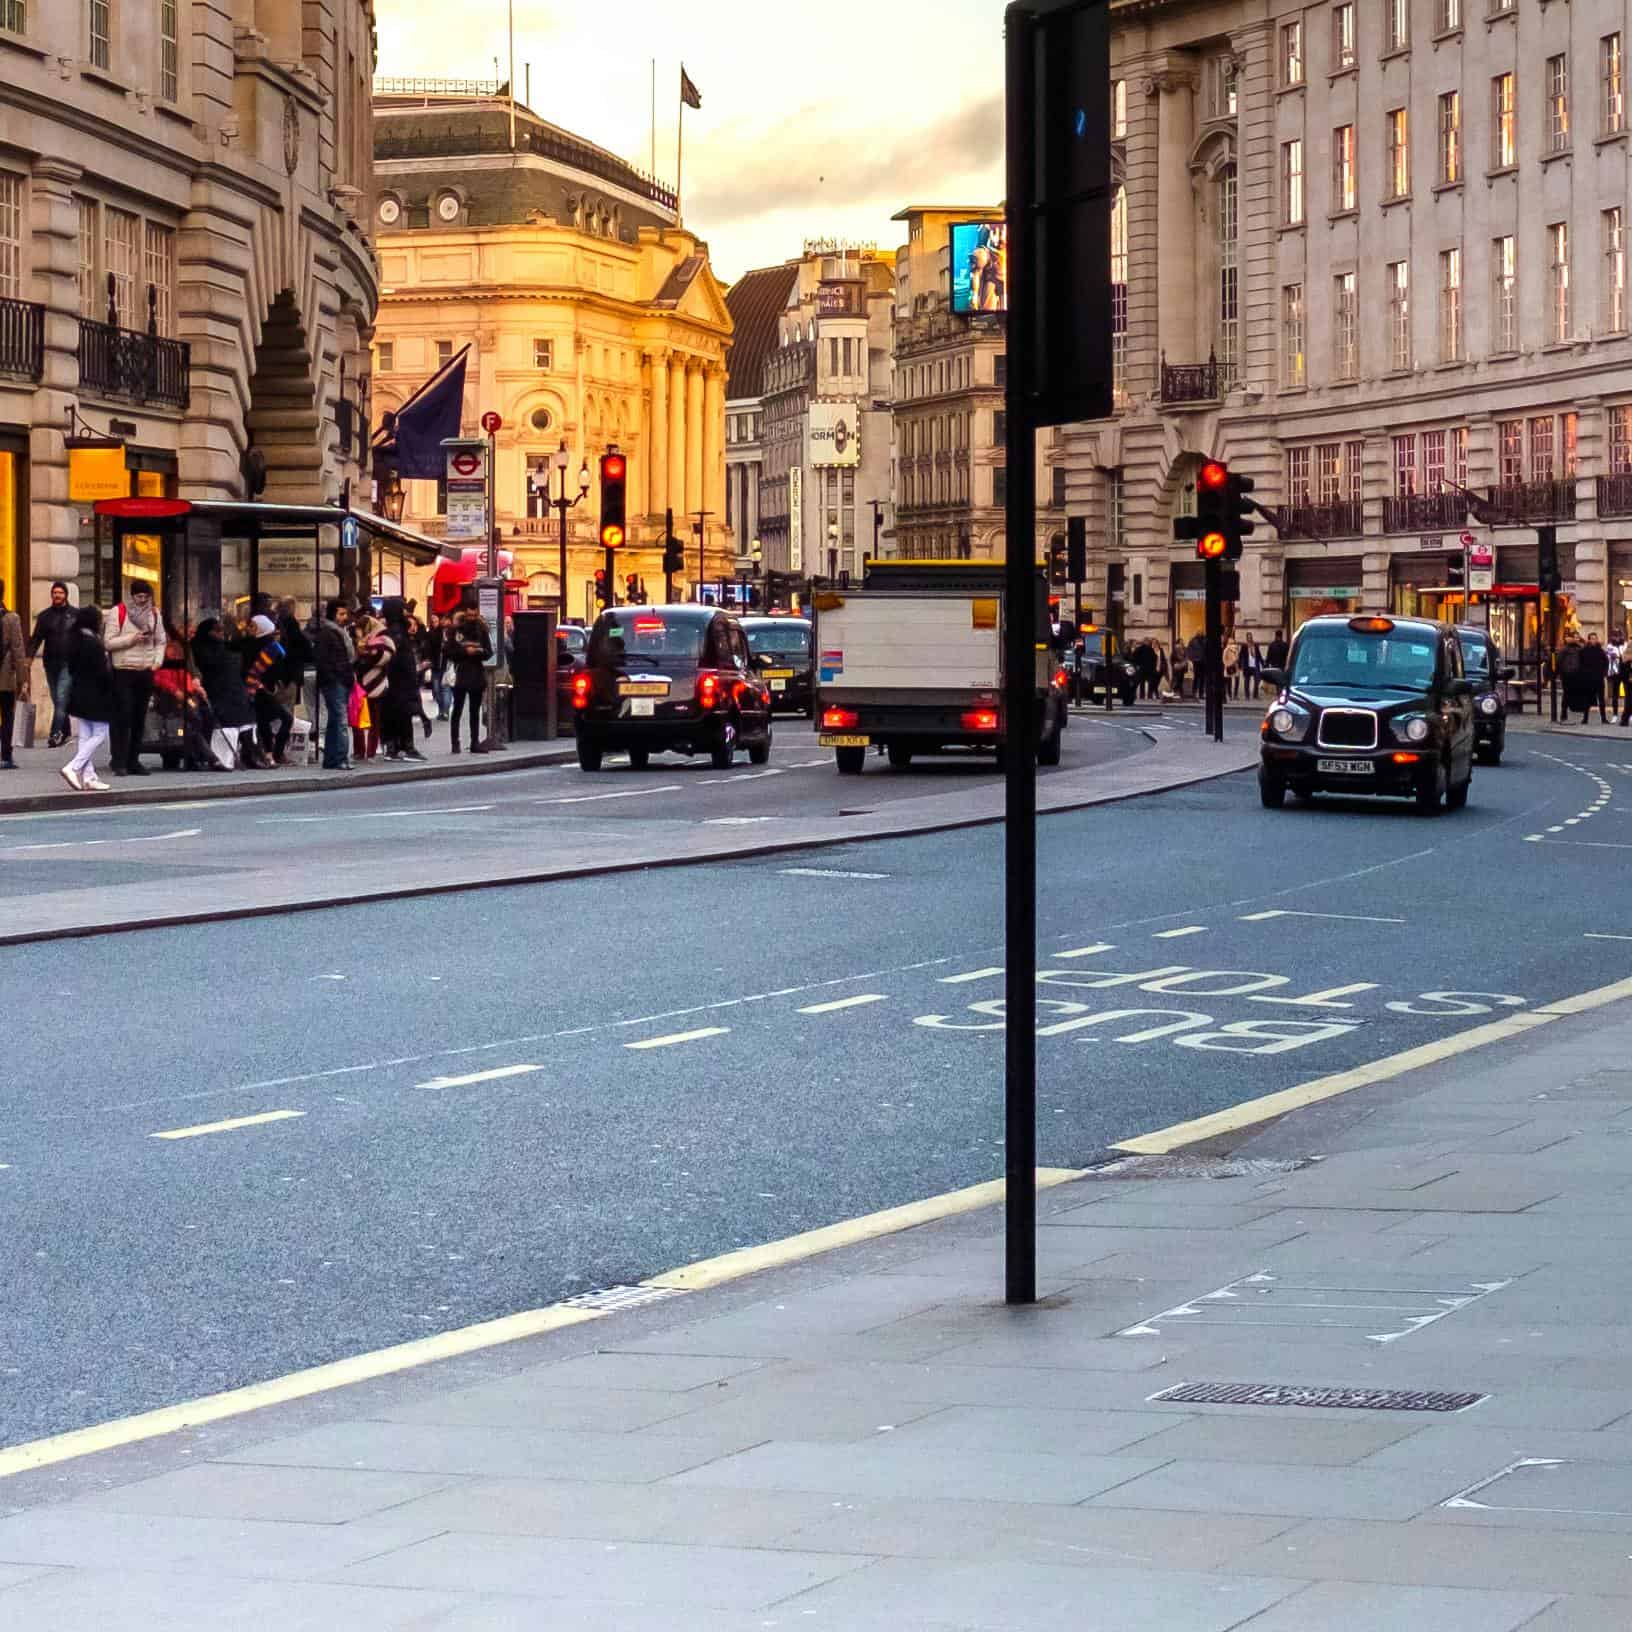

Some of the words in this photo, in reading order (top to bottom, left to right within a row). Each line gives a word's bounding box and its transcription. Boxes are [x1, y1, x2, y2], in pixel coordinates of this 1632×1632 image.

[486, 414, 497, 430] F
[1033, 965, 1528, 1018] STOP
[911, 998, 1360, 1055] BUS
